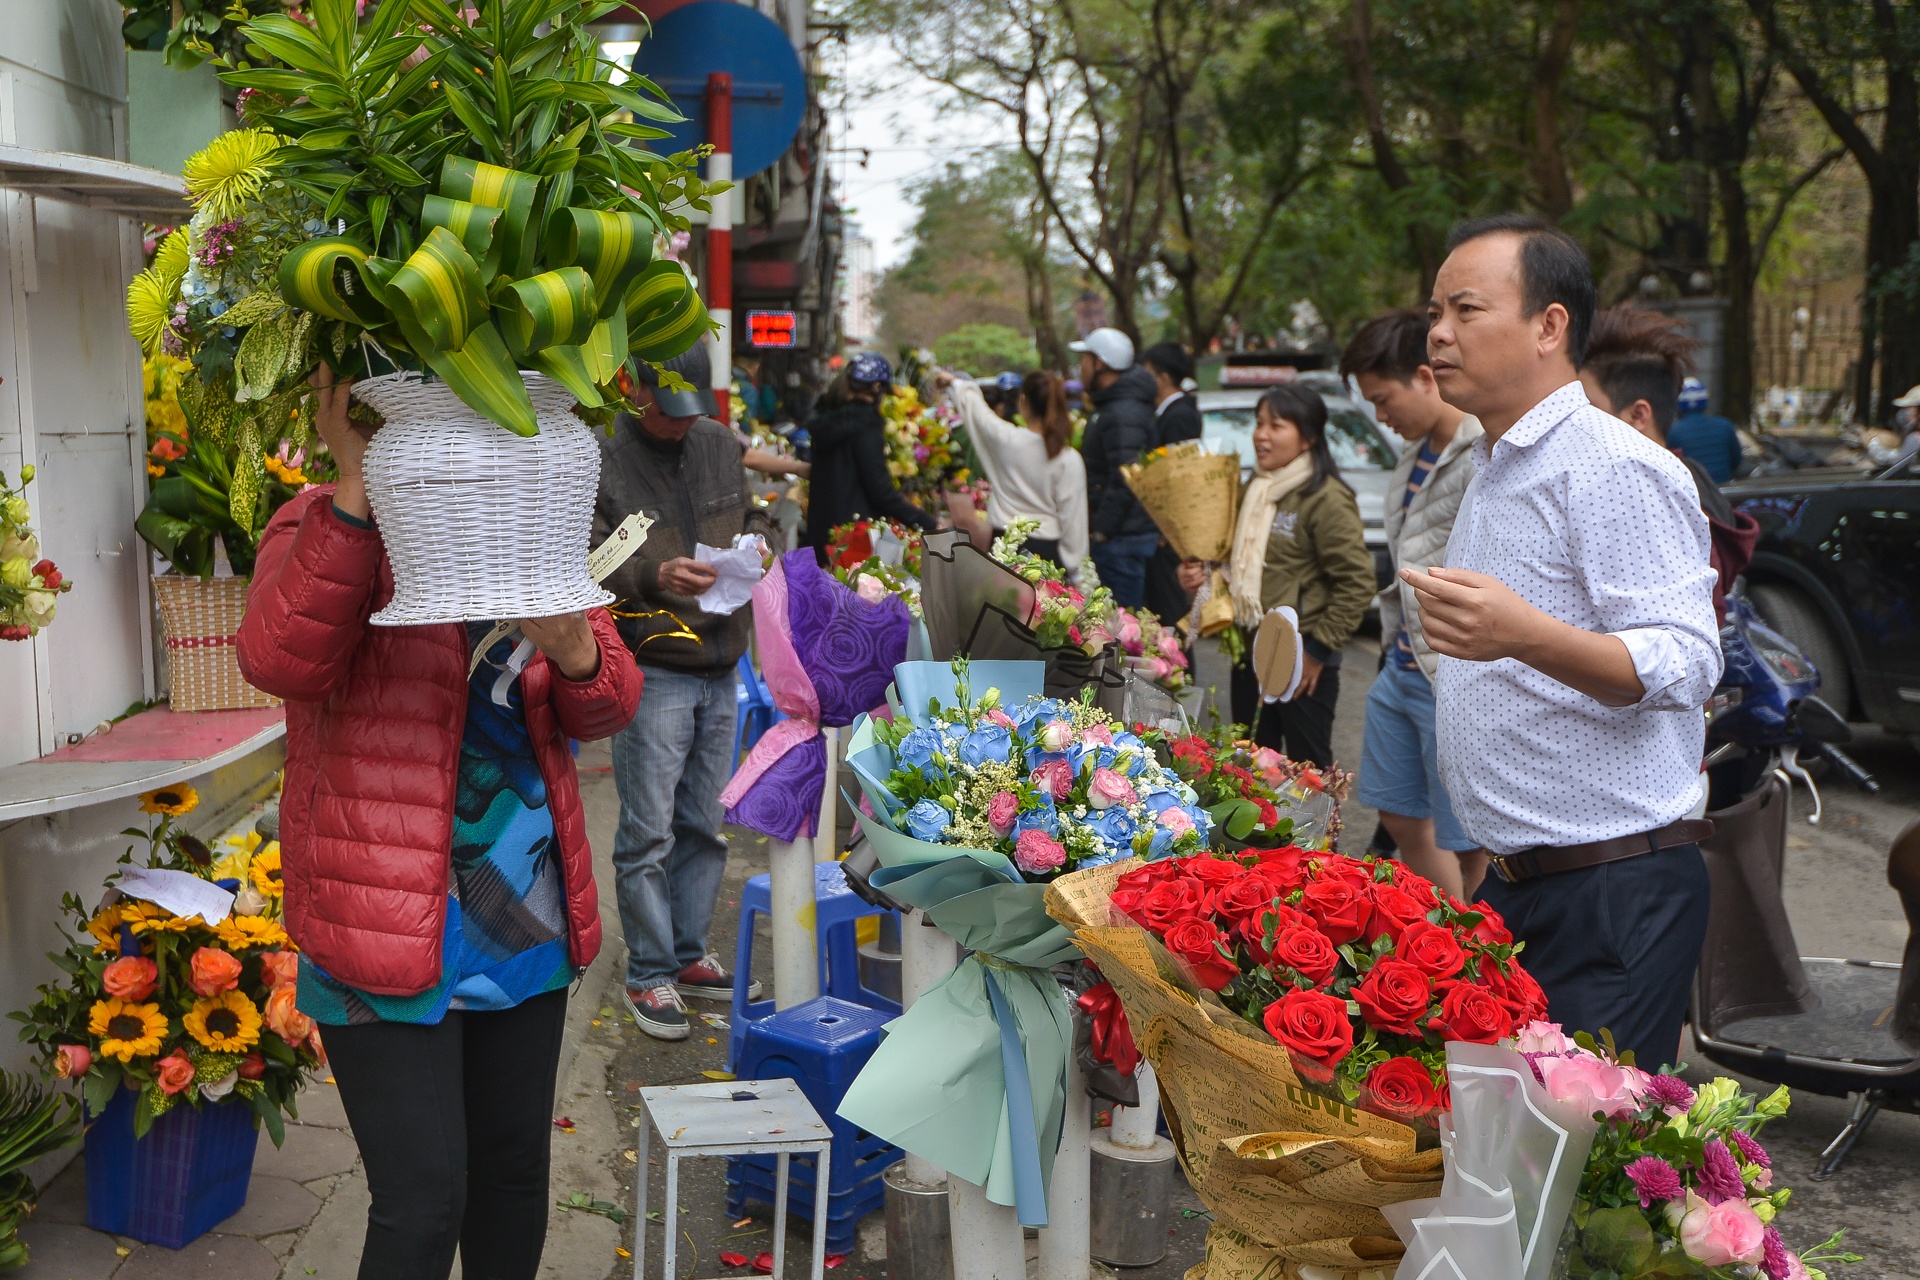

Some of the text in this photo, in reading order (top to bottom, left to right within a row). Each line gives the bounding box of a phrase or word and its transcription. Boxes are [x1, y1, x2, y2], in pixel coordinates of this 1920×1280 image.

[1211, 1068, 1242, 1091] LOVE
[1193, 1085, 1215, 1104] LOVE
[1220, 1097, 1248, 1110] LOVE
[1222, 1087, 1248, 1103] LOVE
[1222, 1104, 1248, 1119] LOVE
[1286, 1083, 1359, 1128] LOVE
[1195, 1111, 1222, 1129] LOVE
[1207, 1108, 1226, 1122] love
[1226, 1116, 1249, 1131] LOVE
[1320, 1114, 1347, 1133] LOVE
[1368, 1122, 1399, 1136] LOVE
[1240, 1210, 1266, 1227] LOVE
[1280, 1211, 1295, 1224] love
[1309, 1211, 1337, 1232] LOVE
[1338, 1210, 1371, 1232] LOVE
[1235, 1217, 1266, 1240] LOVE
[1303, 1221, 1331, 1239] LOV
[1217, 1241, 1237, 1260] OVE
